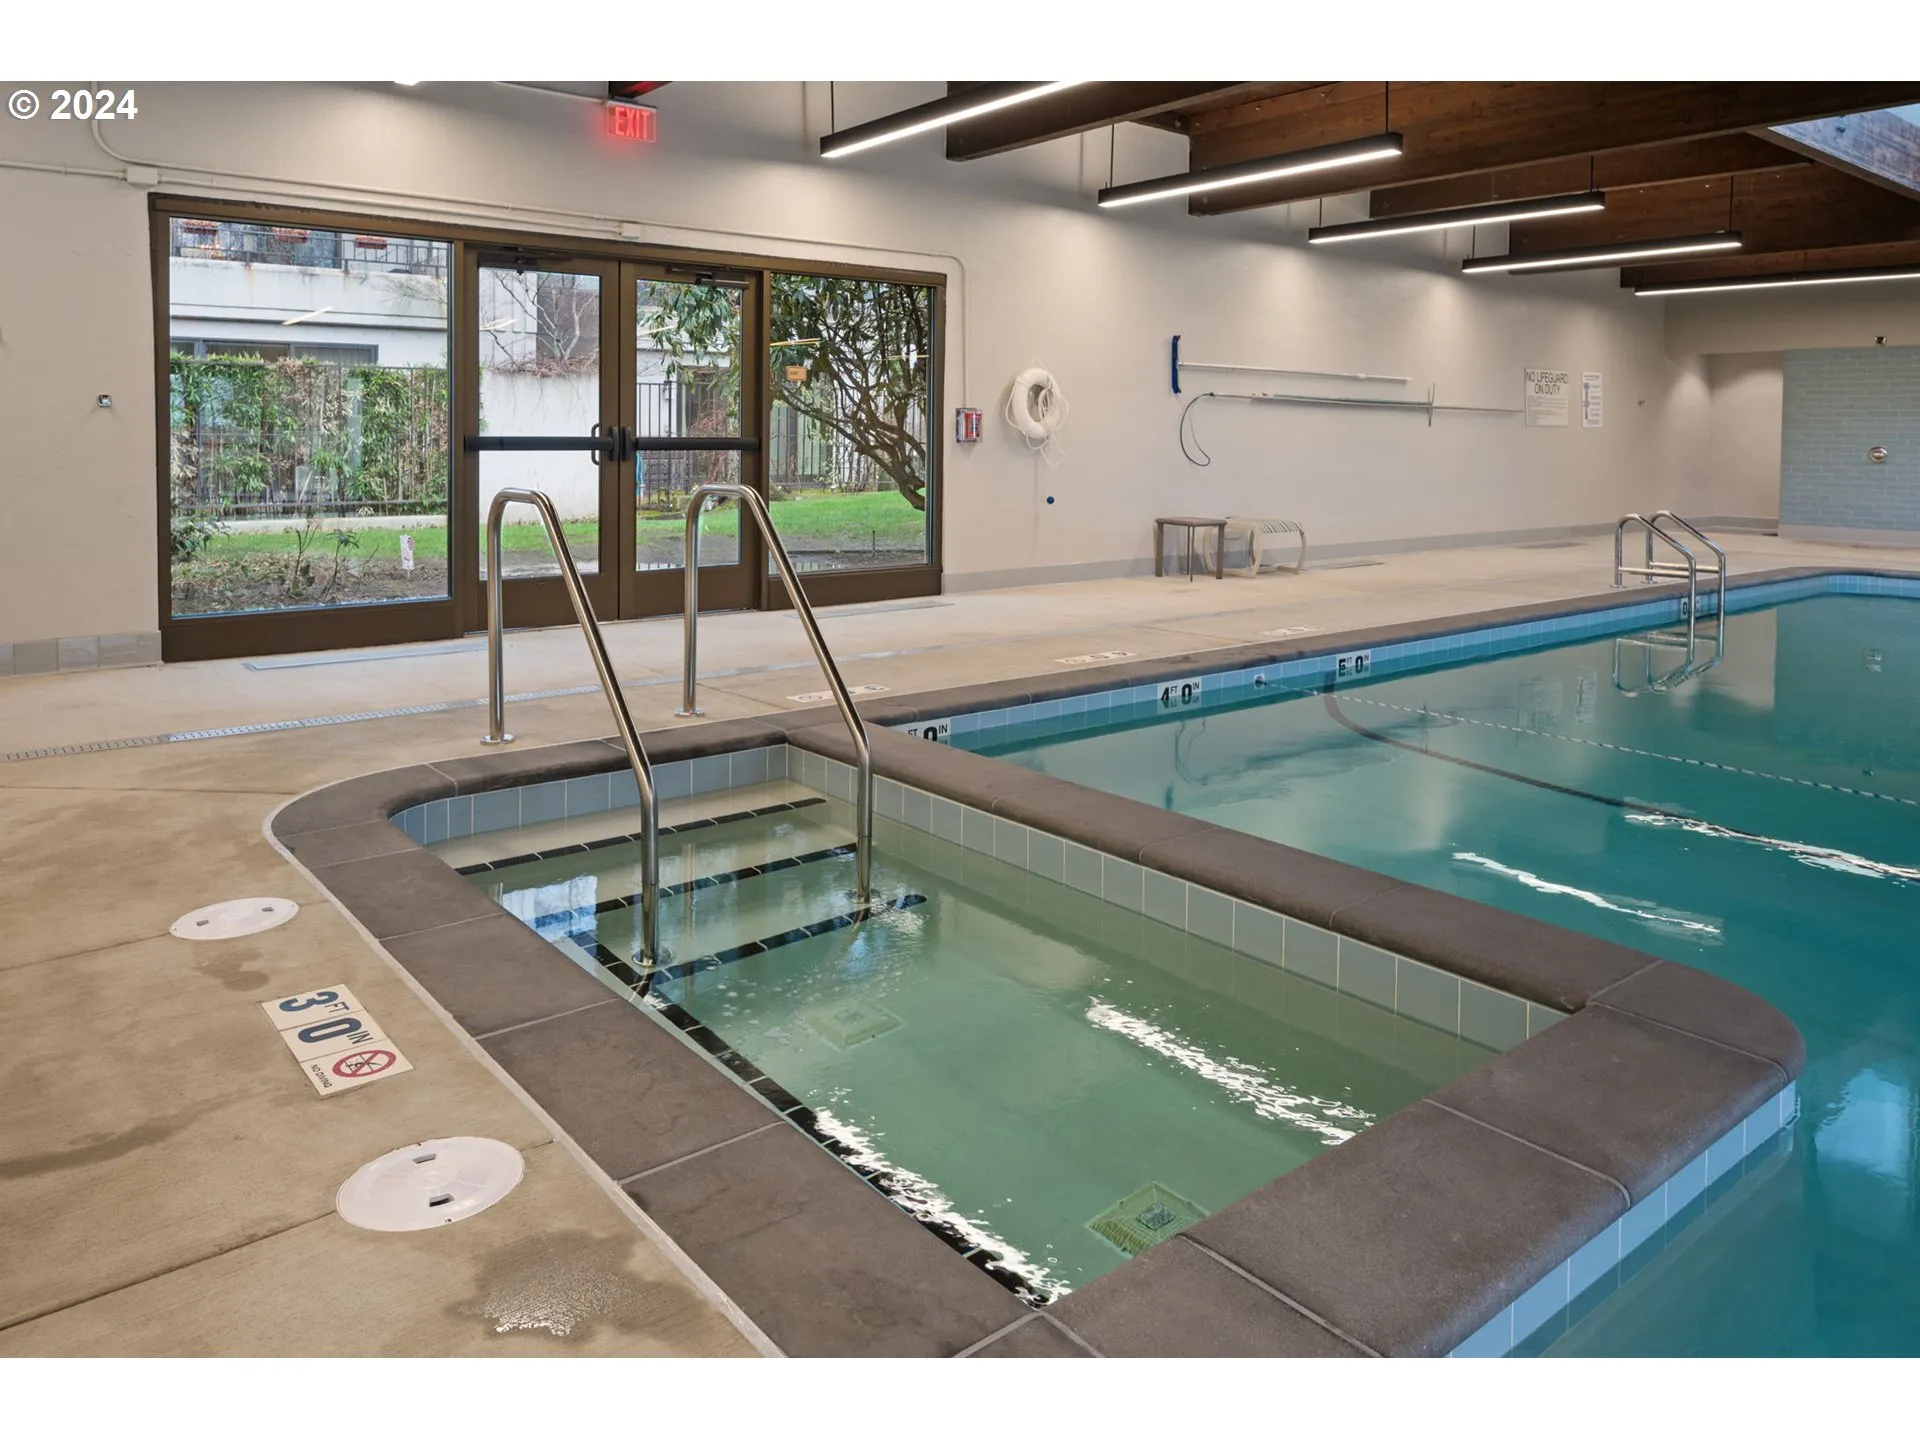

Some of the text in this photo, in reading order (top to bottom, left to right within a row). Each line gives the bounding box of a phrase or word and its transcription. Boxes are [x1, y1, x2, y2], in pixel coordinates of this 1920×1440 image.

[615, 106, 650, 139] EXIT
[1524, 370, 1536, 383] NO
[1536, 371, 1568, 385] LIFEGUARD
[1534, 382, 1561, 395] ON DUTY
[938, 723, 948, 735] IN
[279, 990, 374, 1046] 3 FT 0 IN
[310, 1063, 333, 1089] NO DIVING
